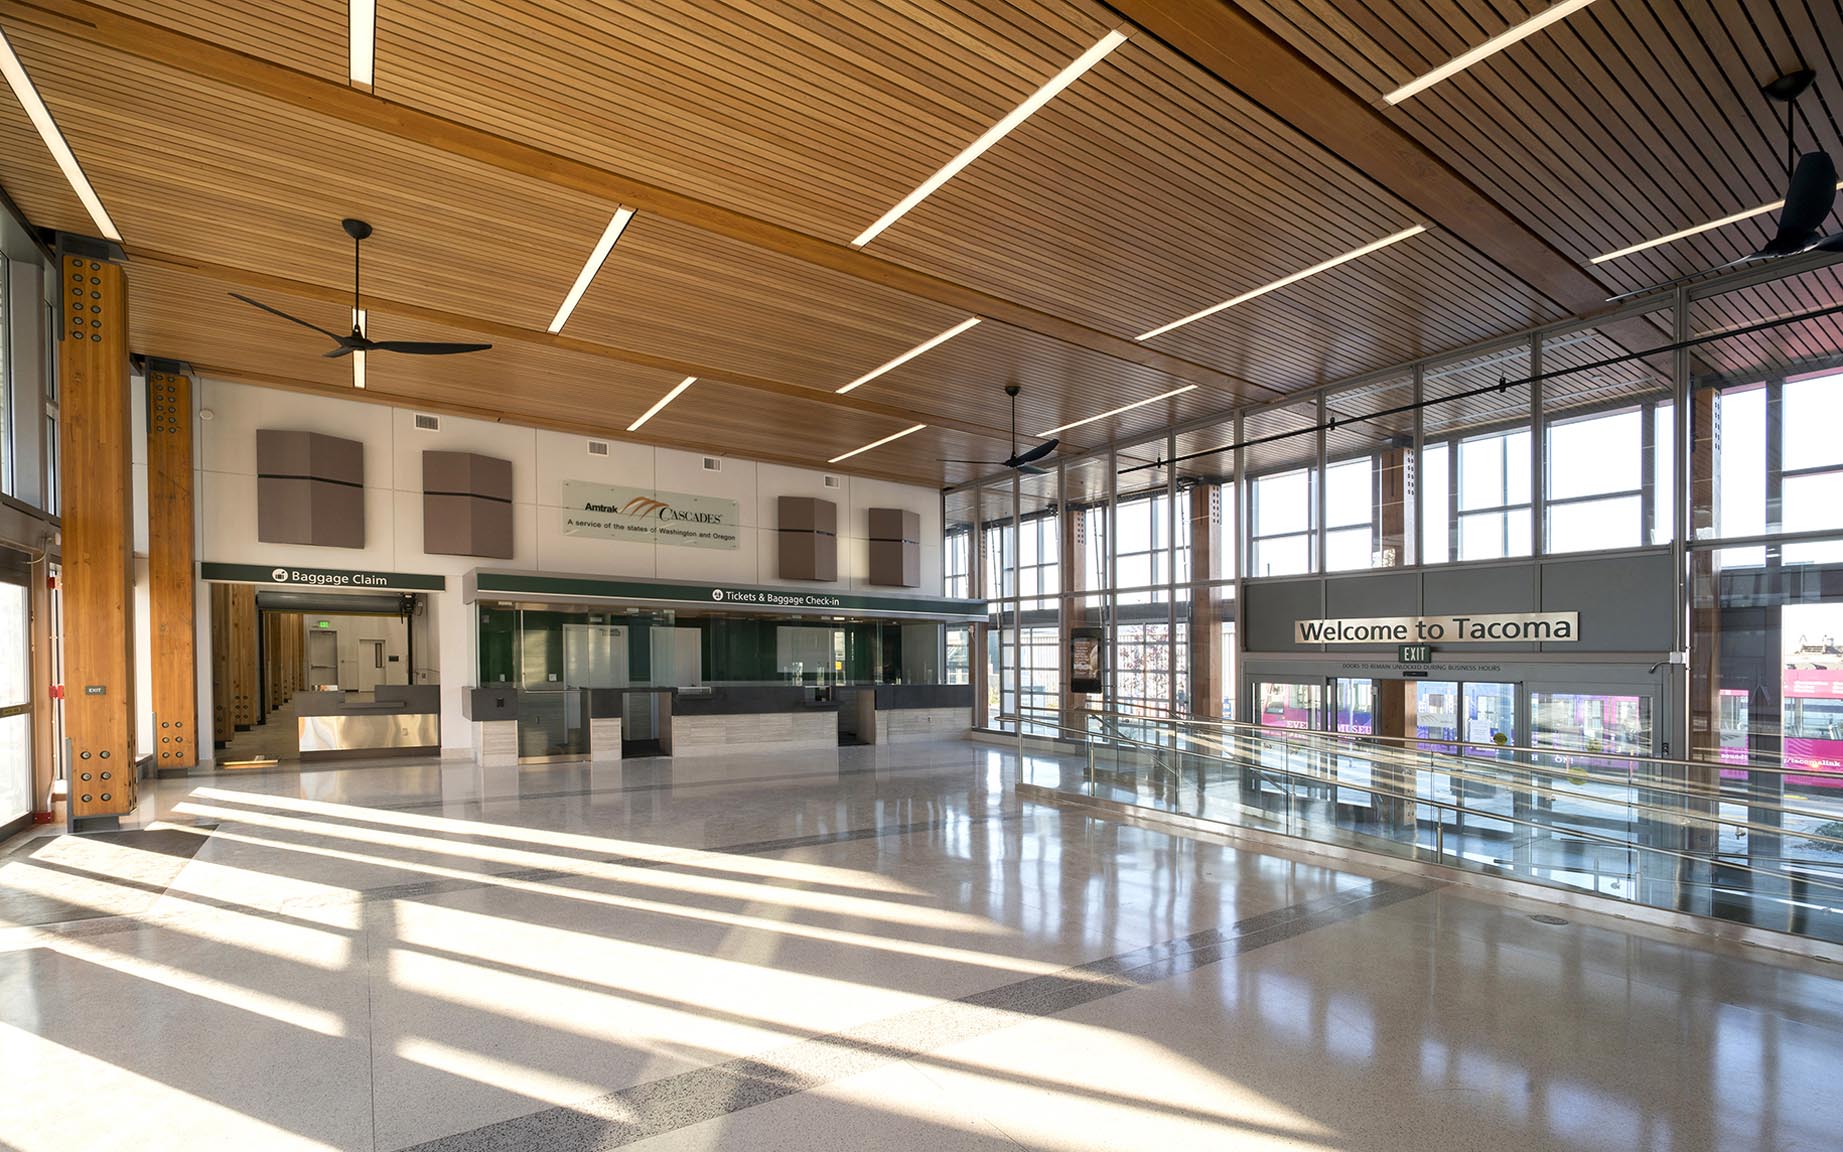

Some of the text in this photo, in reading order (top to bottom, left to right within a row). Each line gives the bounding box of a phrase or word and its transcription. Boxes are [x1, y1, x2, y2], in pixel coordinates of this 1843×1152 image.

[584, 502, 722, 525] Amtrak CASCADES
[567, 518, 574, 526] A
[575, 520, 602, 528] service
[627, 525, 648, 533] states
[659, 527, 697, 538] Washington
[712, 533, 736, 542] Oregon
[292, 571, 388, 586] Baggage Claim
[726, 591, 840, 606] Tickets & Baggage Check-in
[1299, 617, 1571, 641] Welcome to Tacoma
[1403, 646, 1425, 661] EXIT
[1392, 663, 1422, 671] UNLOCKED
[1423, 663, 1447, 671] DURING
[1448, 663, 1477, 671] BUSINESS
[1478, 663, 1501, 672] HOURS
